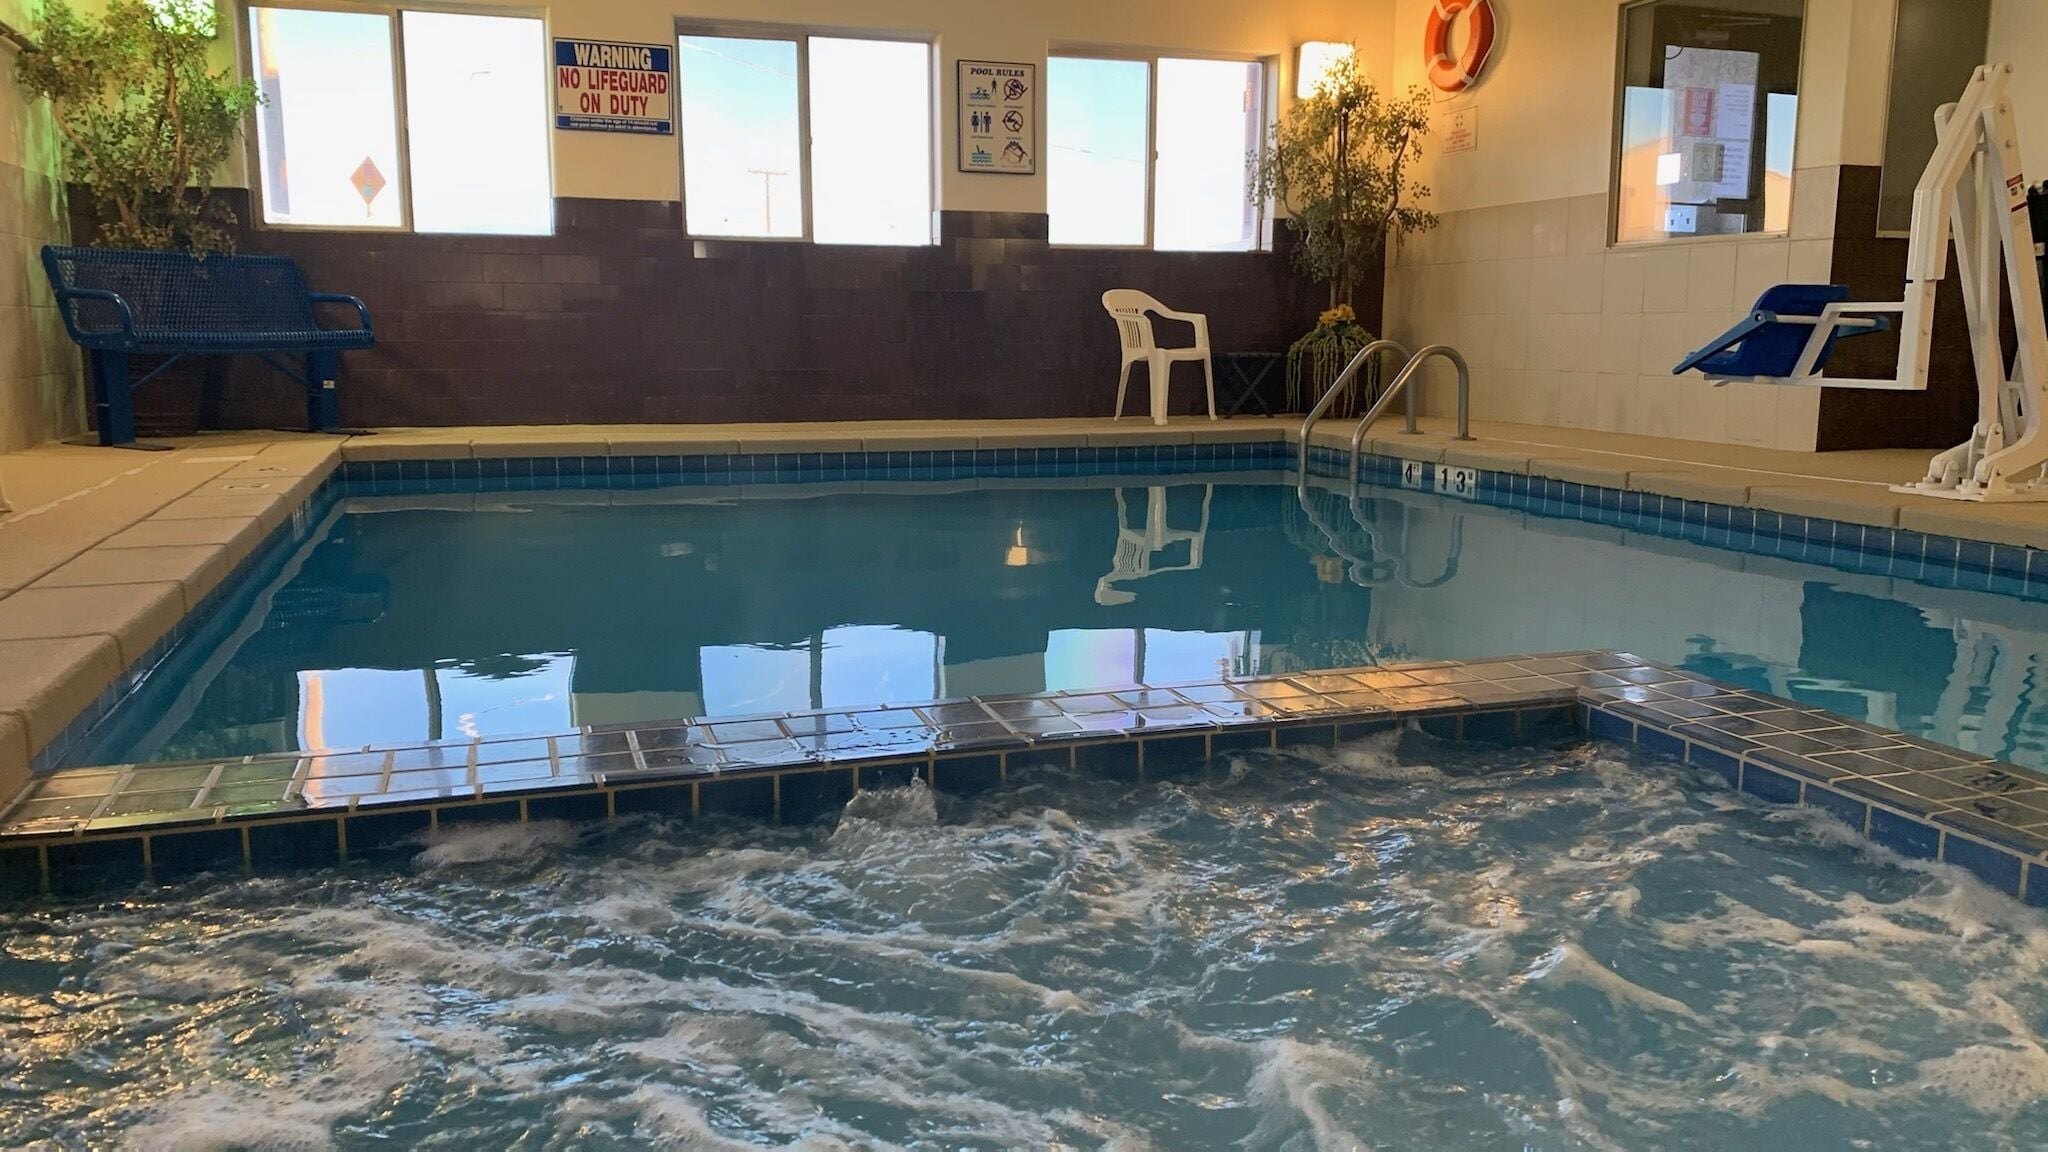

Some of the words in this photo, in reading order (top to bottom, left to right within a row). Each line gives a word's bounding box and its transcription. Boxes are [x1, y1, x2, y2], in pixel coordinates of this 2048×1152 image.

[574, 43, 652, 70] WARNING
[559, 67, 580, 89] NO
[588, 69, 667, 94] LIFEGUARD
[970, 68, 994, 76] POOL
[996, 69, 1025, 77] RULES
[580, 92, 601, 113] ON
[610, 94, 649, 116] DUTY
